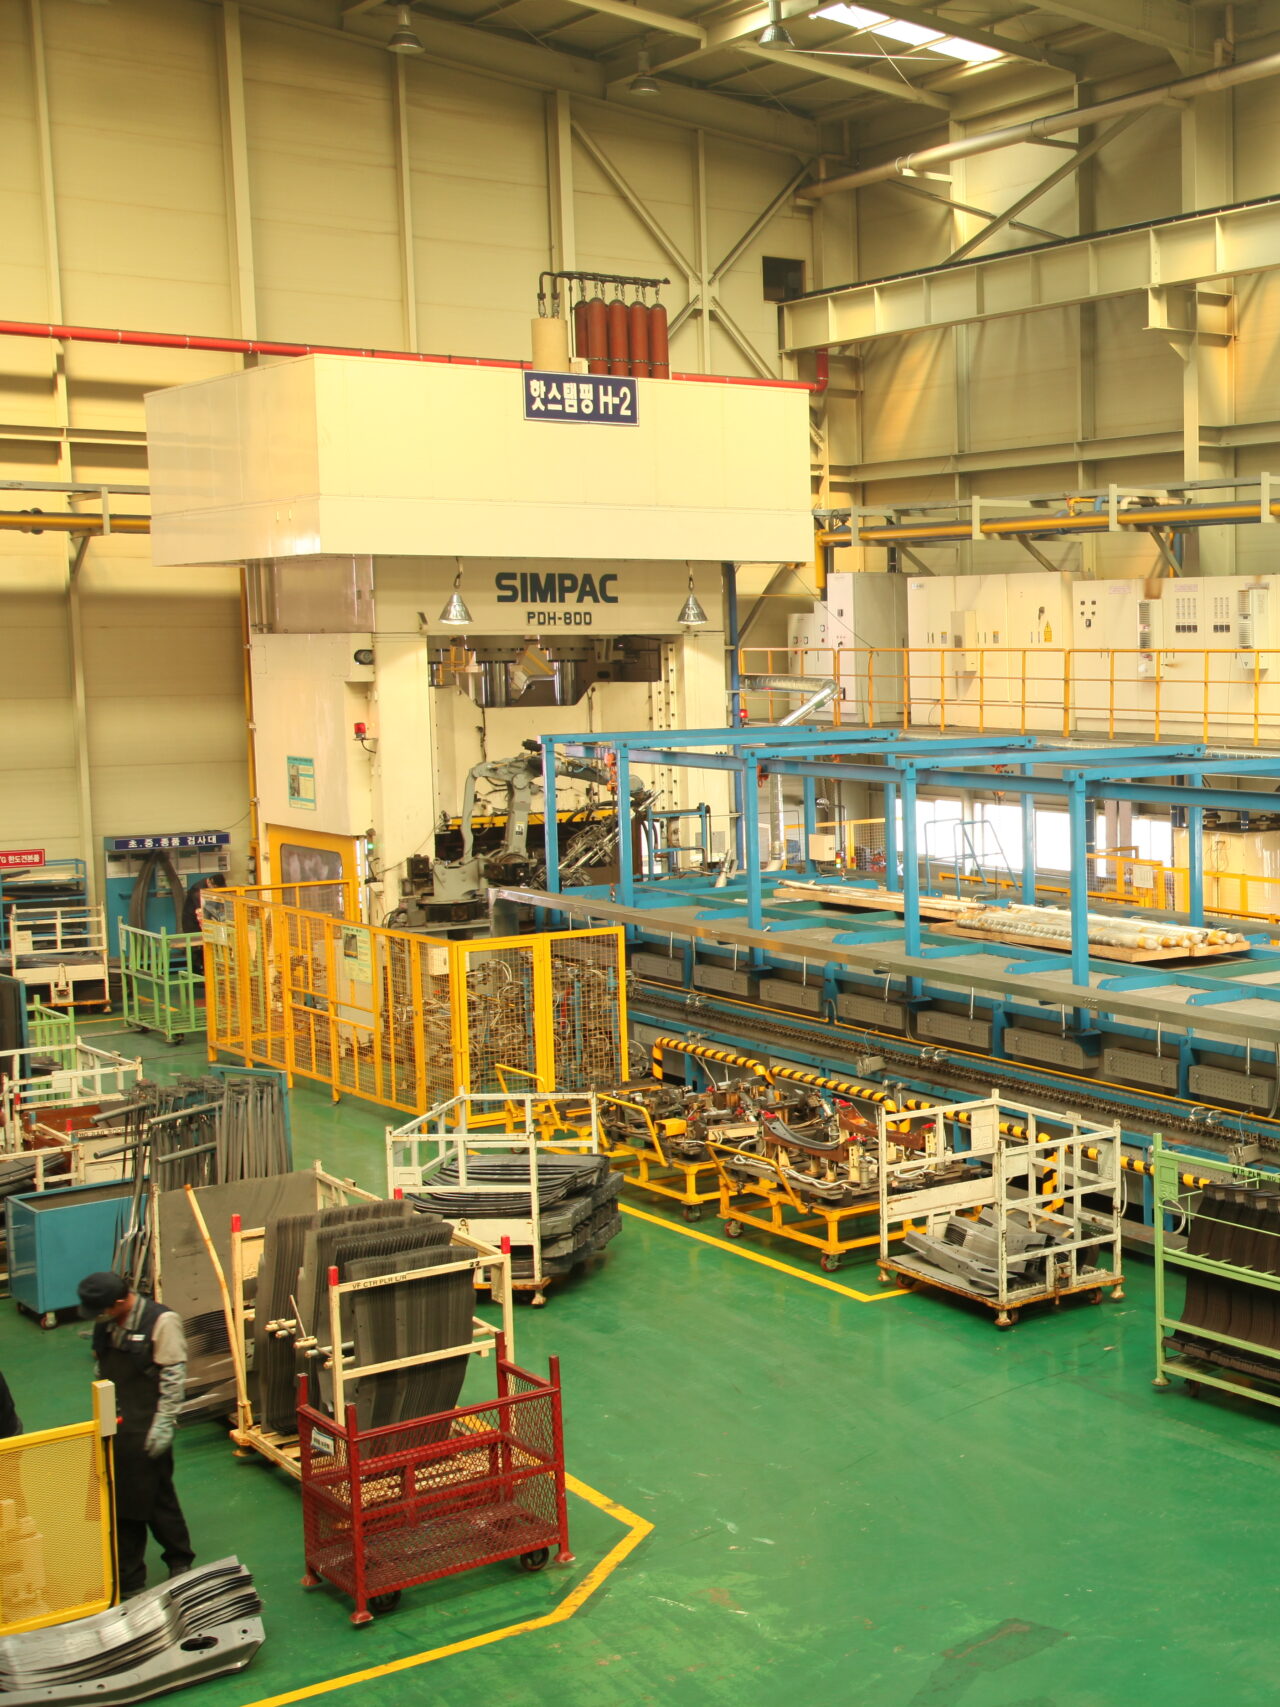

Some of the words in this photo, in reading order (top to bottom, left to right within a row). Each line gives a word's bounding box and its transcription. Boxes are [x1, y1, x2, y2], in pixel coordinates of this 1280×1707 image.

[530, 380, 594, 414] 핫스탬핑
[599, 385, 632, 416] H-2
[495, 572, 619, 603] SIMPAC
[527, 612, 592, 625] PDH-800
[187, 835, 217, 846] 검사대
[1232, 1167, 1244, 1175] CTR
[469, 1260, 480, 1268] 22
[363, 1280, 378, 1288] CTR
